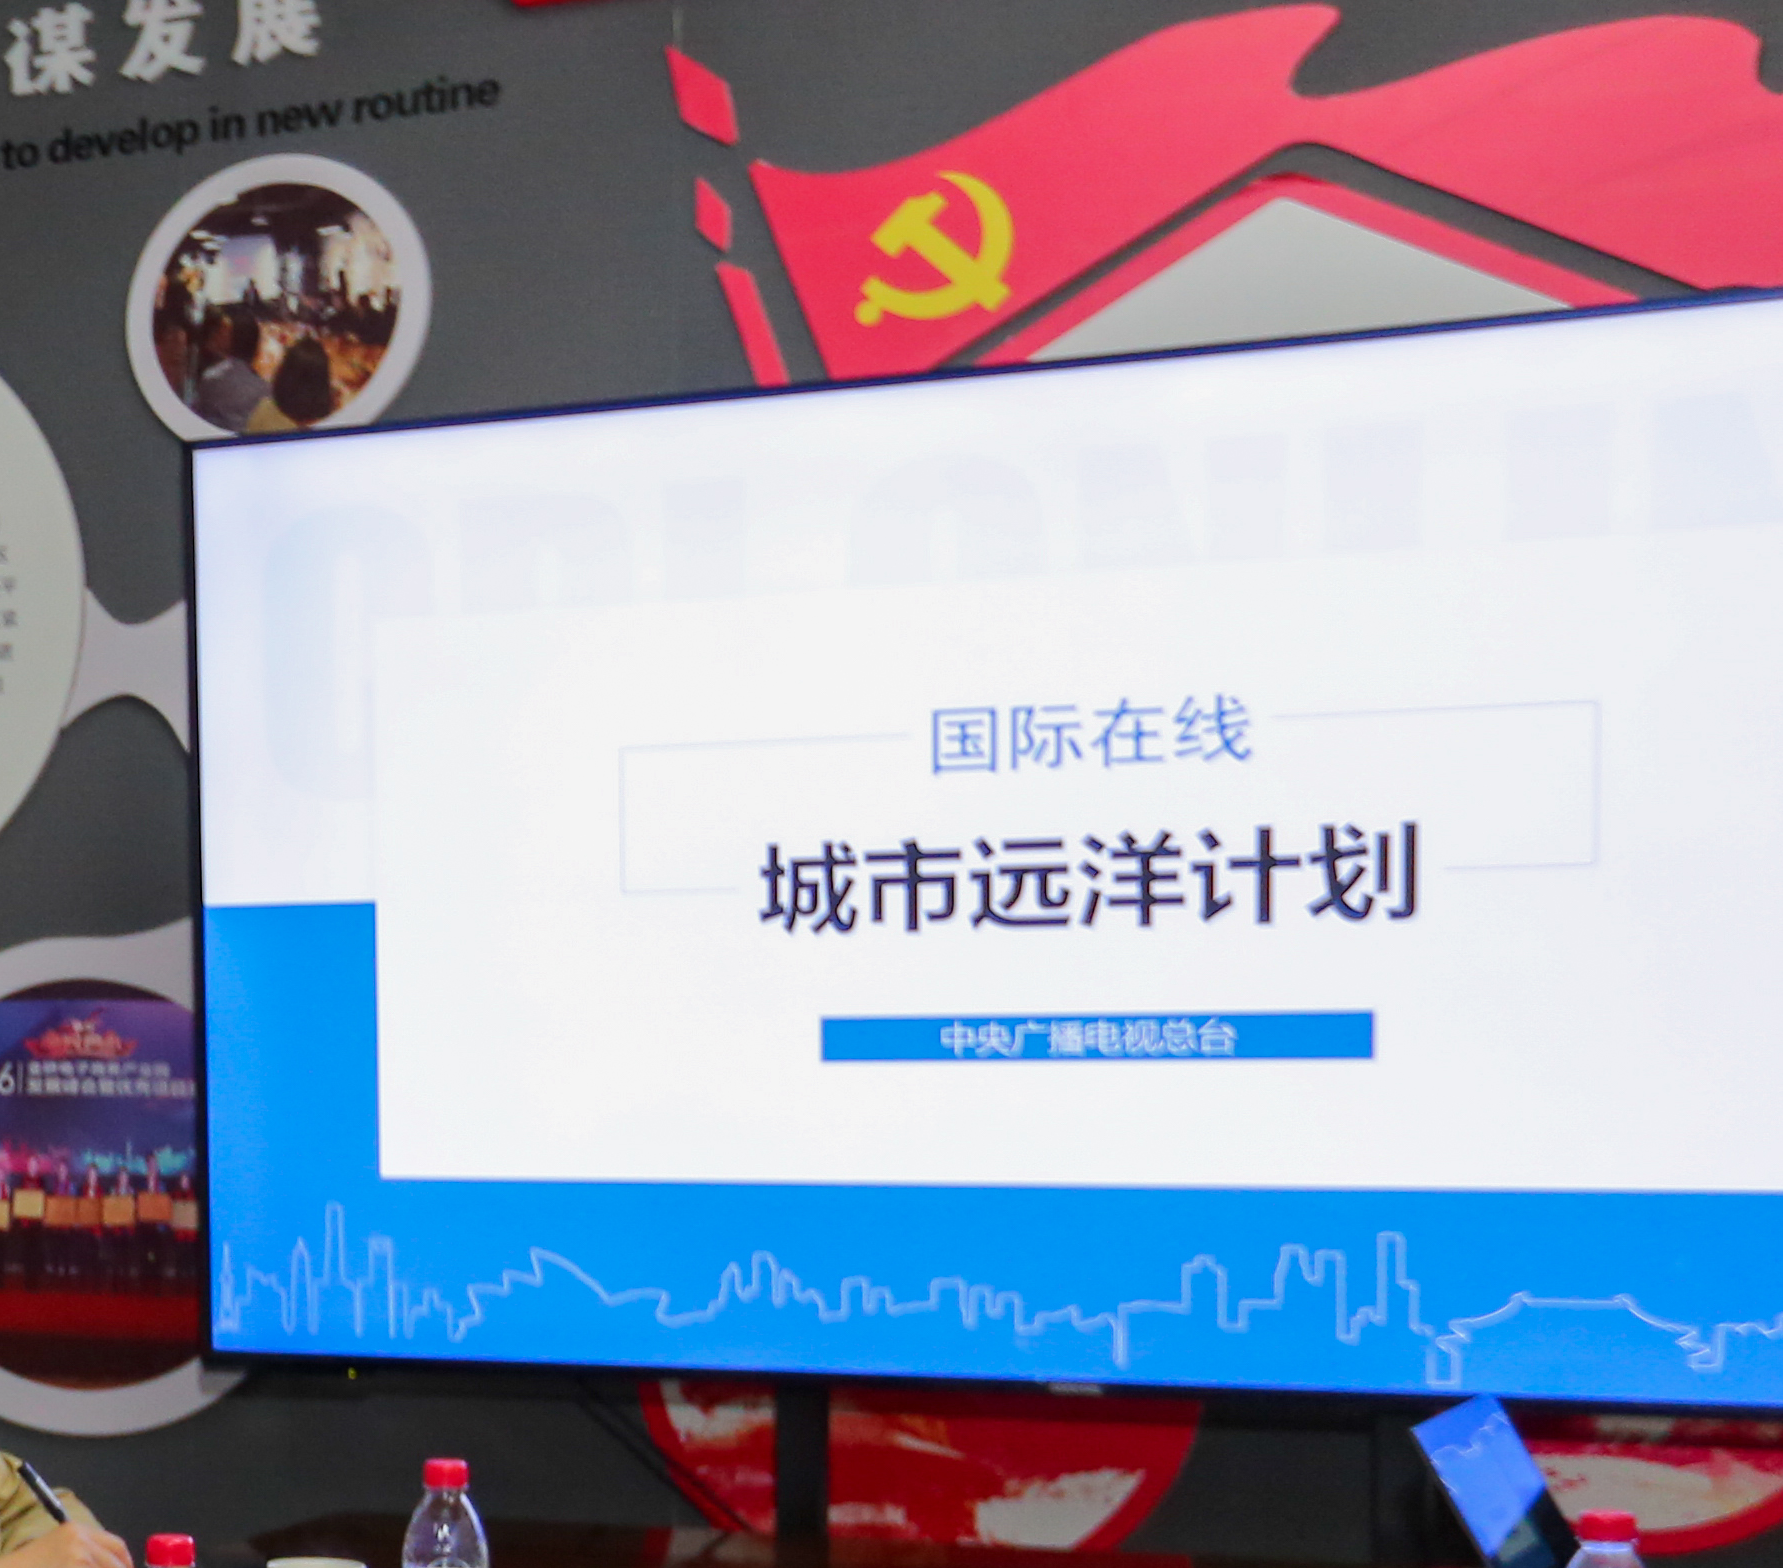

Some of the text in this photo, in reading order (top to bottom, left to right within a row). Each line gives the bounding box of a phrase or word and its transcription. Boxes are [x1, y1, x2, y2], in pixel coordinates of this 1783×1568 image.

[0, 138, 41, 172] to
[48, 113, 199, 165] develop
[209, 104, 247, 142] in
[256, 99, 340, 138] new
[350, 75, 502, 124] routine
[929, 693, 1254, 777] 国际在线
[758, 820, 1420, 935] 城市远洋计划
[938, 1018, 1240, 1059] 中央广播电视总台
